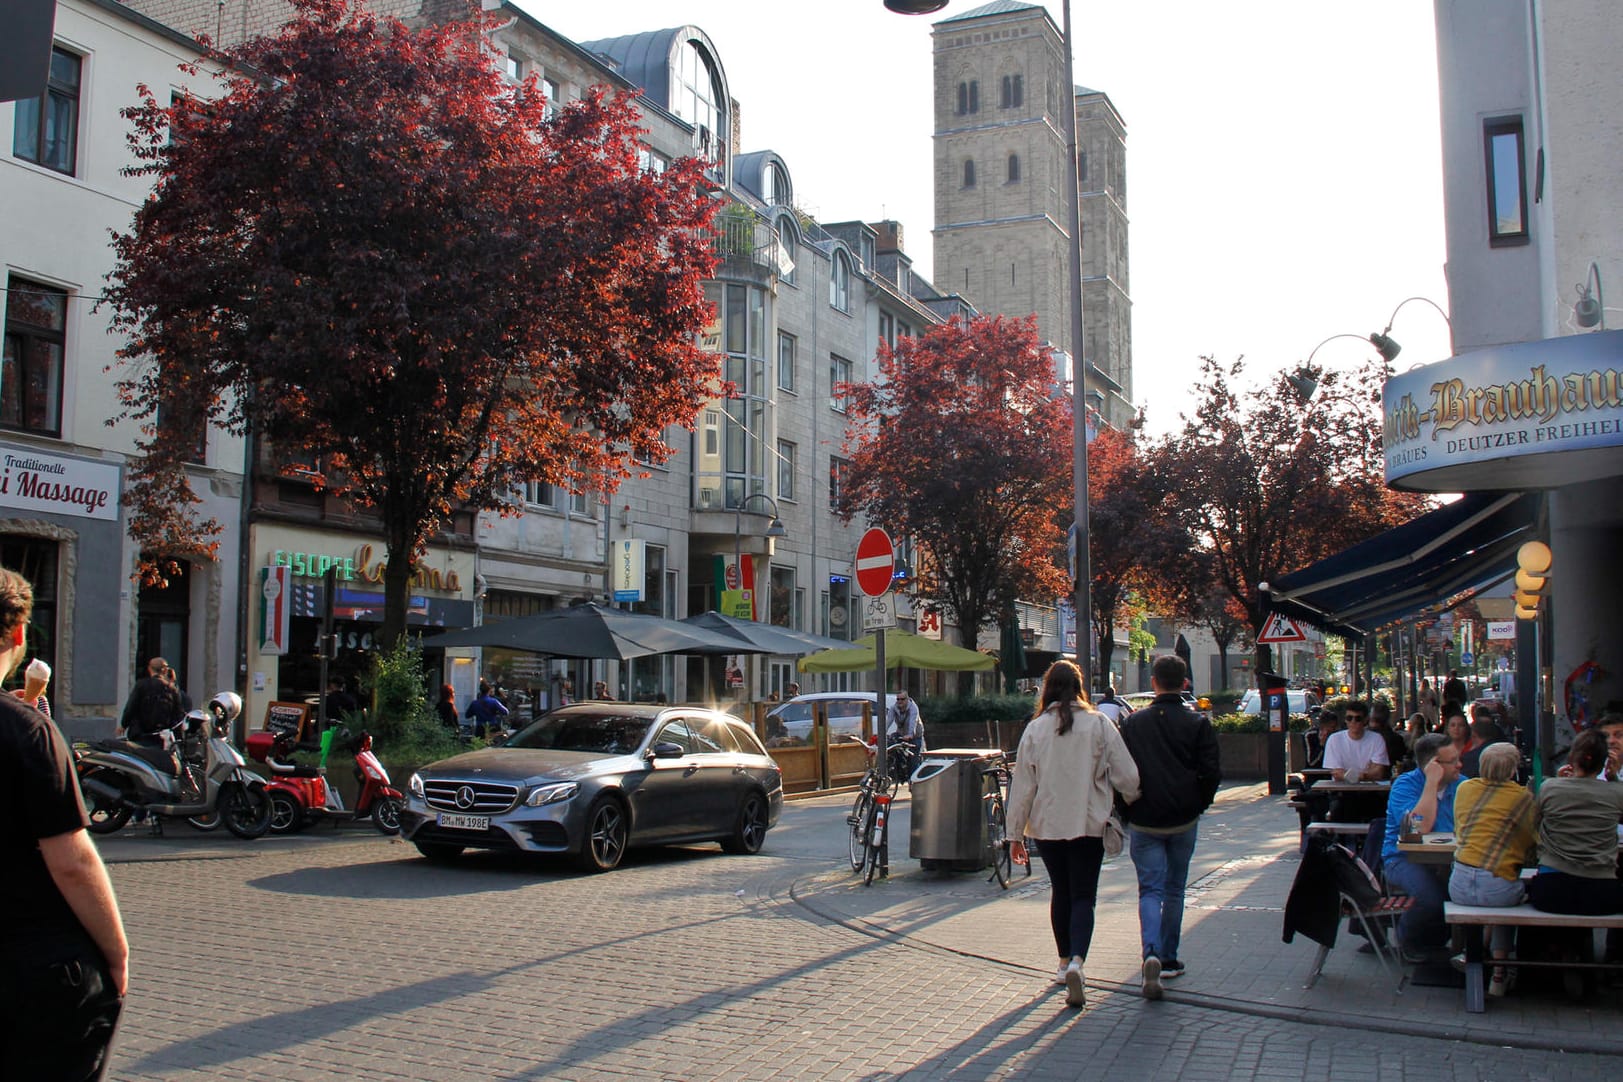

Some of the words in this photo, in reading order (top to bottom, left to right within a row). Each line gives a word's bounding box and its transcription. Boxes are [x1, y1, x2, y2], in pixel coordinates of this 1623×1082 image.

[1447, 430, 1529, 454] DEUTZER
[1535, 418, 1623, 443] FREIHEI
[5, 454, 66, 475] Traditionelle
[0, 468, 9, 494] i
[16, 471, 108, 513] Massage
[1271, 696, 1279, 707] P
